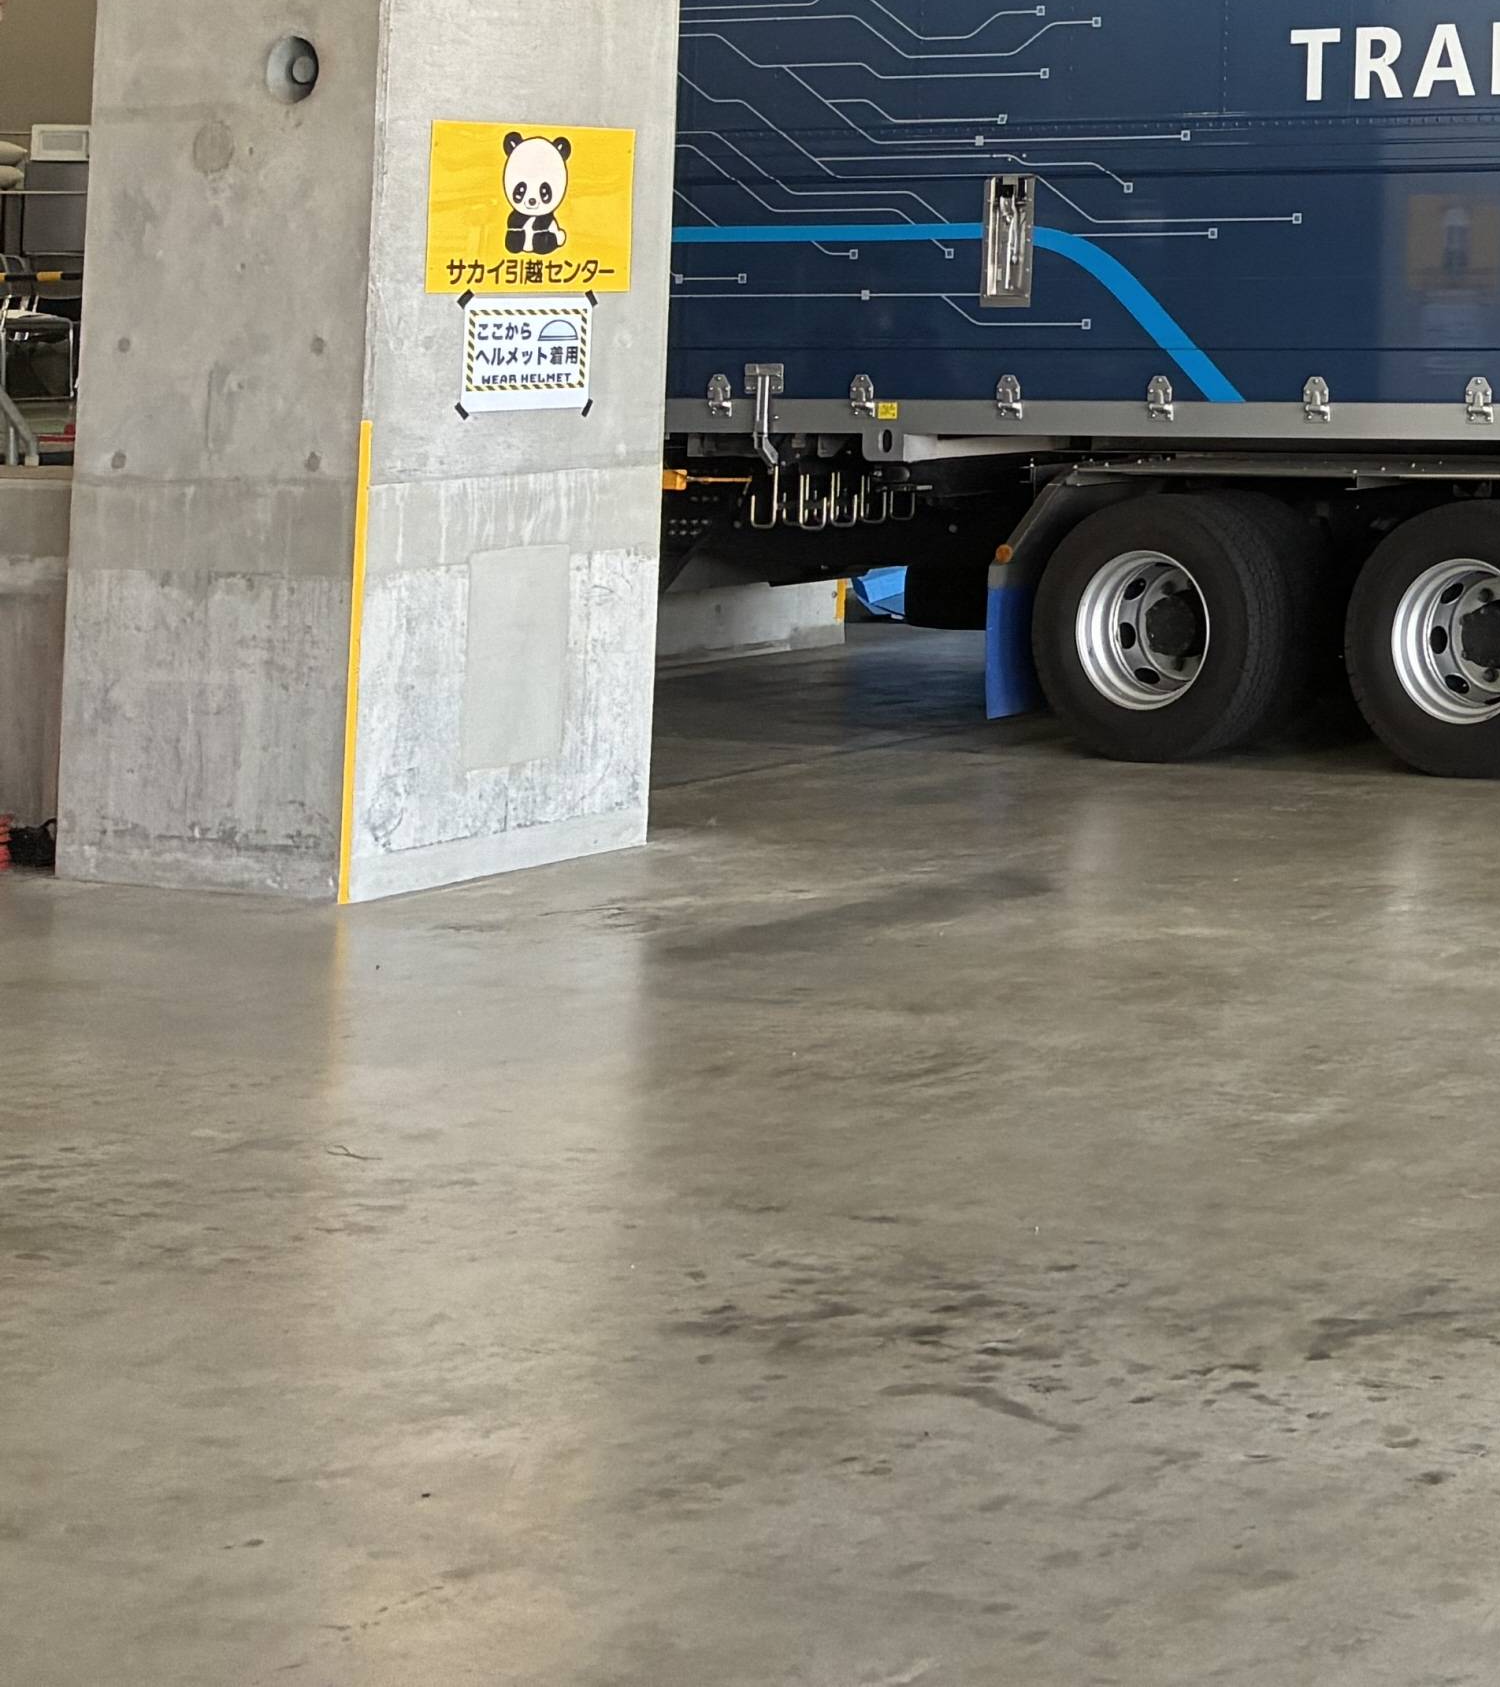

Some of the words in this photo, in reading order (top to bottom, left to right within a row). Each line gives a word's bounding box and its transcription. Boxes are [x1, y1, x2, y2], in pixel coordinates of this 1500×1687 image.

[446, 259, 616, 285] サカイ引越センター
[477, 321, 532, 341] ここから
[475, 345, 579, 366] ヘルメット着用
[481, 374, 517, 385] WEAR
[520, 372, 572, 384] HELMET
